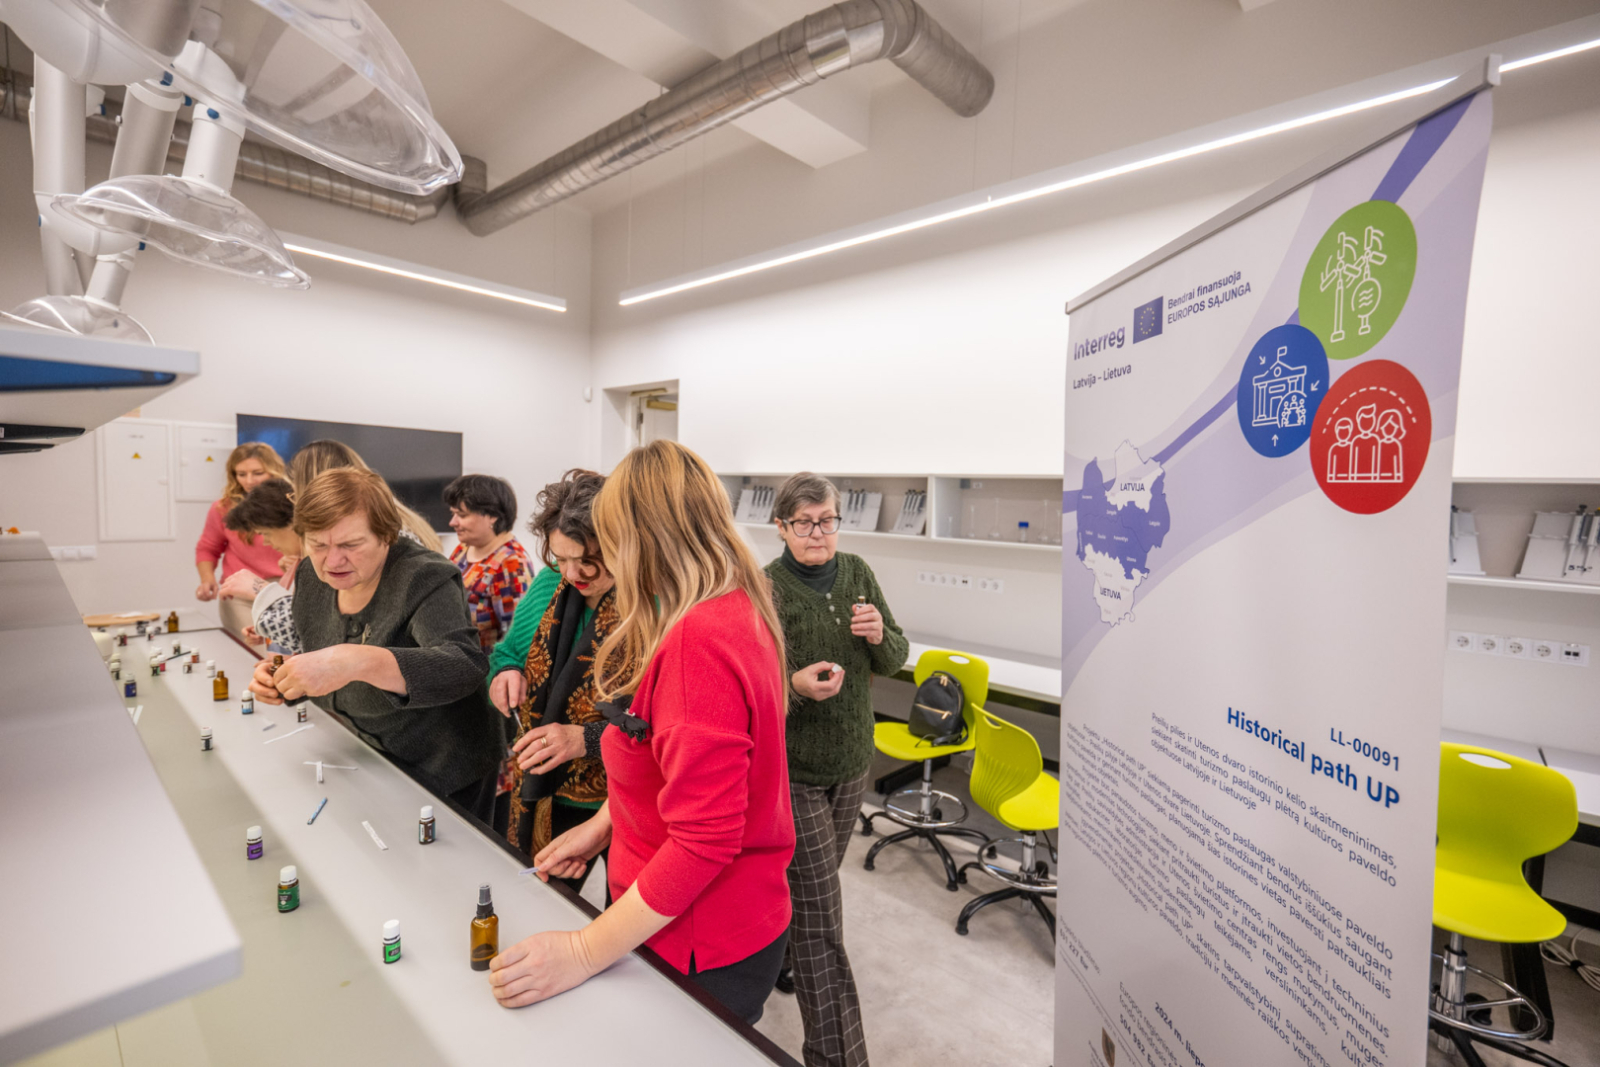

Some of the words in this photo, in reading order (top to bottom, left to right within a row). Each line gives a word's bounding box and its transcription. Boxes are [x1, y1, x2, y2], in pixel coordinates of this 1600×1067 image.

[1168, 288, 1195, 309] Bendrai
[1197, 270, 1242, 296] finansuoja
[1168, 300, 1205, 324] EUROPOS
[1208, 282, 1252, 308] SĄJUNGA
[1073, 326, 1126, 361] Interreg
[1073, 373, 1096, 390] Latvija
[1103, 364, 1132, 381] Lietuva
[1120, 482, 1145, 492] LATVIJA
[1100, 586, 1122, 600] LIETUVA
[1182, 758, 1210, 782] Latvijoje
[1211, 775, 1218, 786] ir
[1219, 780, 1256, 810] Lietuvoje
[1187, 732, 1192, 743] ir
[1194, 737, 1219, 759] Utenos
[1222, 754, 1246, 772] dvaro
[1248, 766, 1283, 794] istorinio
[1286, 787, 1306, 810] kelio
[1309, 806, 1396, 868] skaitmeninimas,
[1227, 707, 1305, 762] Historical
[1310, 754, 1358, 790] path
[1366, 774, 1400, 809] UP
[1330, 727, 1400, 771] LL-00091
[1174, 741, 1197, 760] skatinti
[1199, 755, 1229, 778] turizmo
[1232, 775, 1271, 805] paslaugų
[1275, 800, 1300, 824] plėtrą
[1303, 816, 1343, 852] kultūros
[1348, 850, 1396, 887] paveldo
[1162, 794, 1179, 812] dvare
[1180, 807, 1211, 837] Lietuvoje.
[1214, 832, 1263, 874] Sprendžiant
[1266, 868, 1302, 904] bendrus
[1305, 899, 1341, 938] iššūkius
[1345, 936, 1392, 980] saugant
[1168, 813, 1205, 846] planuojama
[1207, 840, 1221, 858] šias
[1223, 853, 1258, 886] istorines
[1260, 882, 1286, 908] vietas
[1289, 905, 1324, 941] paversti
[1327, 939, 1390, 998] patraukliais
[1171, 789, 1200, 814] pagerinti
[1201, 809, 1230, 835] turizmo
[1232, 832, 1275, 866] paslaugas
[1278, 863, 1342, 920] valstybiniuose
[1346, 918, 1392, 959] paveldo
[1168, 863, 1190, 890] Utenos
[1193, 886, 1223, 919] švietimo
[1226, 918, 1257, 948] centras
[1262, 948, 1288, 975] rengs
[1293, 976, 1339, 1029] mokymus,
[1171, 855, 1200, 884] pritraukti
[1202, 881, 1229, 910] turistus
[1232, 905, 1239, 917] ir
[1241, 913, 1273, 946] įtraukti
[1276, 944, 1304, 973] vietos
[1306, 970, 1388, 1058] bendruomenes.
[1176, 886, 1205, 919] paslaugų
[1214, 920, 1252, 962] teikėjams,
[1264, 966, 1327, 1034] verslininkams,
[1178, 846, 1184, 856] ir
[1186, 852, 1214, 882] švietimo
[1216, 880, 1263, 923] platformos,
[1267, 918, 1321, 975] investuojant
[1332, 978, 1389, 1038] techninius
[1185, 934, 1212, 969] tradicijų
[1213, 962, 1220, 974] ir
[1221, 972, 1255, 1010] meninės
[1257, 1008, 1289, 1044] raiškos
[1196, 933, 1220, 961] skatins
[1223, 959, 1280, 1020] tarpvalstybinį
[1154, 1002, 1173, 1029] 2024
[1173, 1028, 1184, 1045] m.
